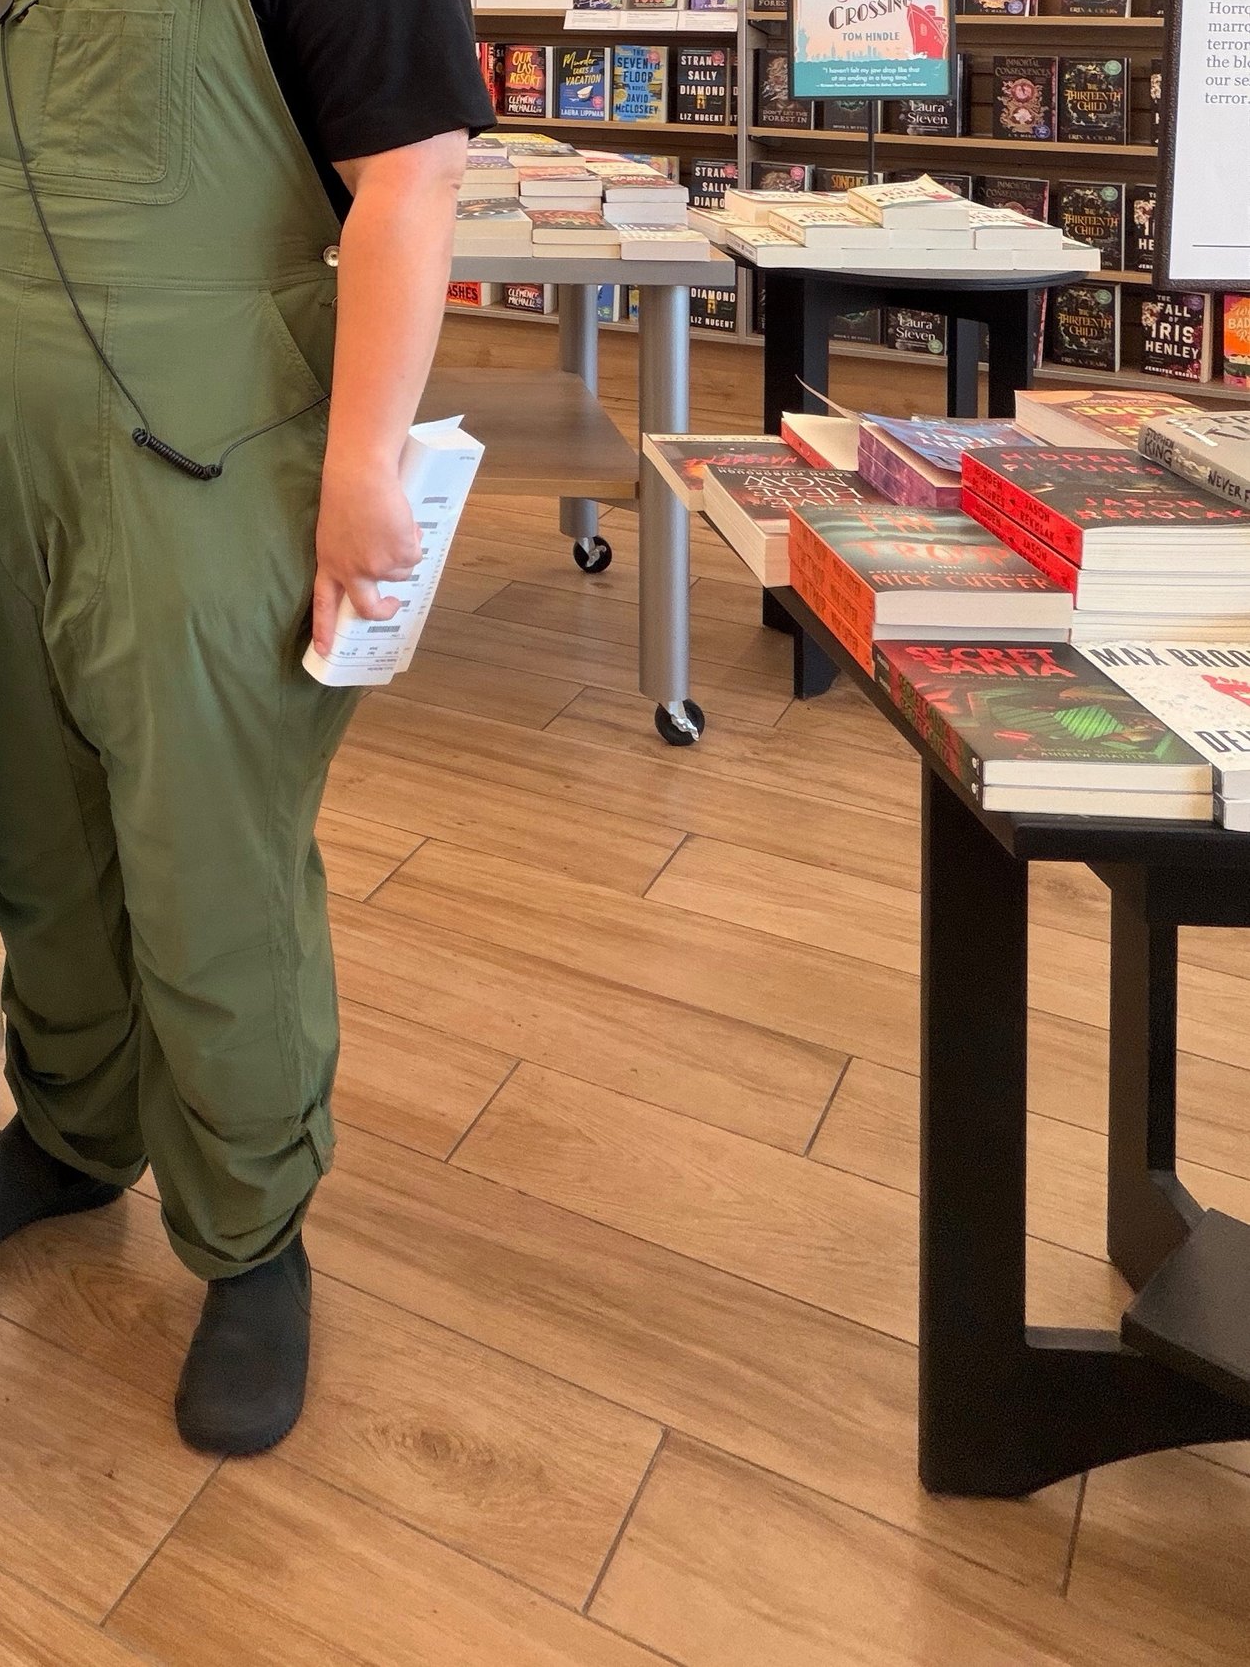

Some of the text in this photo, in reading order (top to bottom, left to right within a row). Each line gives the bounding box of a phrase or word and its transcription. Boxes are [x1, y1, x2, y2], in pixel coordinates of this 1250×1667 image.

[842, 31, 900, 41] TOM HINDLE
[512, 50, 533, 66] OUR
[562, 50, 597, 68] Murder
[1206, 55, 1230, 69] the
[516, 63, 538, 75] LAST
[687, 69, 717, 82] SALLY
[994, 67, 1051, 78] CONSEQUENCES
[509, 73, 542, 87] RESORT
[565, 73, 602, 86] VACATION
[623, 70, 654, 84] FLOOR
[1205, 75, 1231, 86] our
[679, 84, 726, 97] DIAMOND
[1063, 89, 1121, 102] THIRTEENTH
[626, 93, 649, 104] DAVID
[560, 108, 604, 118] LAURA LIPPMAN
[614, 103, 659, 116] McCLOSKEY
[909, 101, 945, 113] Laura
[1077, 100, 1107, 112] CHILD
[679, 112, 724, 123] LIZ NUGENT
[762, 115, 808, 124] FOREST IN
[906, 112, 949, 126] Steven
[1062, 212, 1119, 228] THIRTEENTH
[1074, 224, 1104, 236] CHILD
[690, 287, 736, 303] DIAMOND
[1156, 294, 1172, 303] THE
[1157, 301, 1192, 318] FALL
[690, 316, 734, 329] LIZ NUGENT
[899, 314, 933, 330] Laura
[1058, 313, 1112, 329] THIRTEENTH
[895, 326, 936, 342] Steven
[1069, 325, 1098, 337] CHILD
[1152, 322, 1195, 344] IRIS
[1145, 339, 1199, 360] HENLEY
[1146, 427, 1175, 450] STEPHEN
[999, 452, 1132, 465] HIDDEN
[1143, 439, 1173, 468] KING
[743, 474, 849, 488] NOW
[973, 464, 1002, 490] HIDDEN
[1207, 469, 1243, 500] NEVER
[753, 485, 865, 499] HERE
[1022, 494, 1051, 523] JASON
[1085, 497, 1206, 509] JASON
[1019, 511, 1055, 544] REKULAK
[870, 573, 1052, 591] NICK CUTTER
[904, 644, 1058, 666] SECRET
[1087, 647, 1172, 669] MAX
[927, 660, 1079, 680] SANTA
